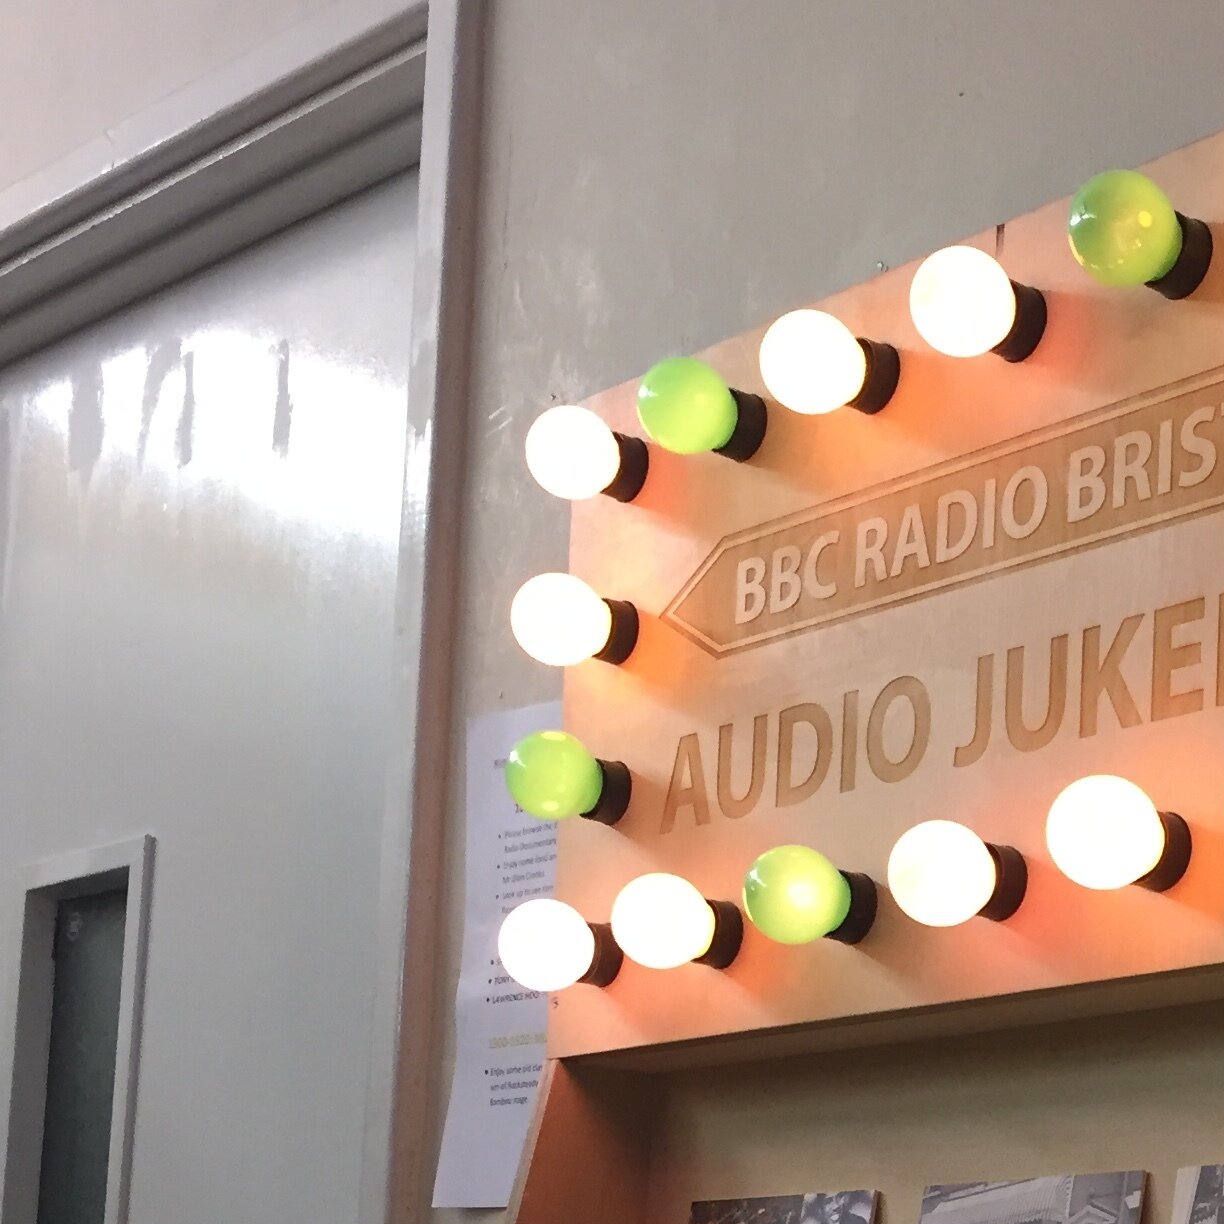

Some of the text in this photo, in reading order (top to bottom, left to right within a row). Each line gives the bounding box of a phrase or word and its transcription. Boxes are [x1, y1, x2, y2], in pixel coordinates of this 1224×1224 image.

[733, 533, 839, 625] BBC
[853, 466, 1048, 588] RADIO
[659, 675, 932, 834] AUDIO
